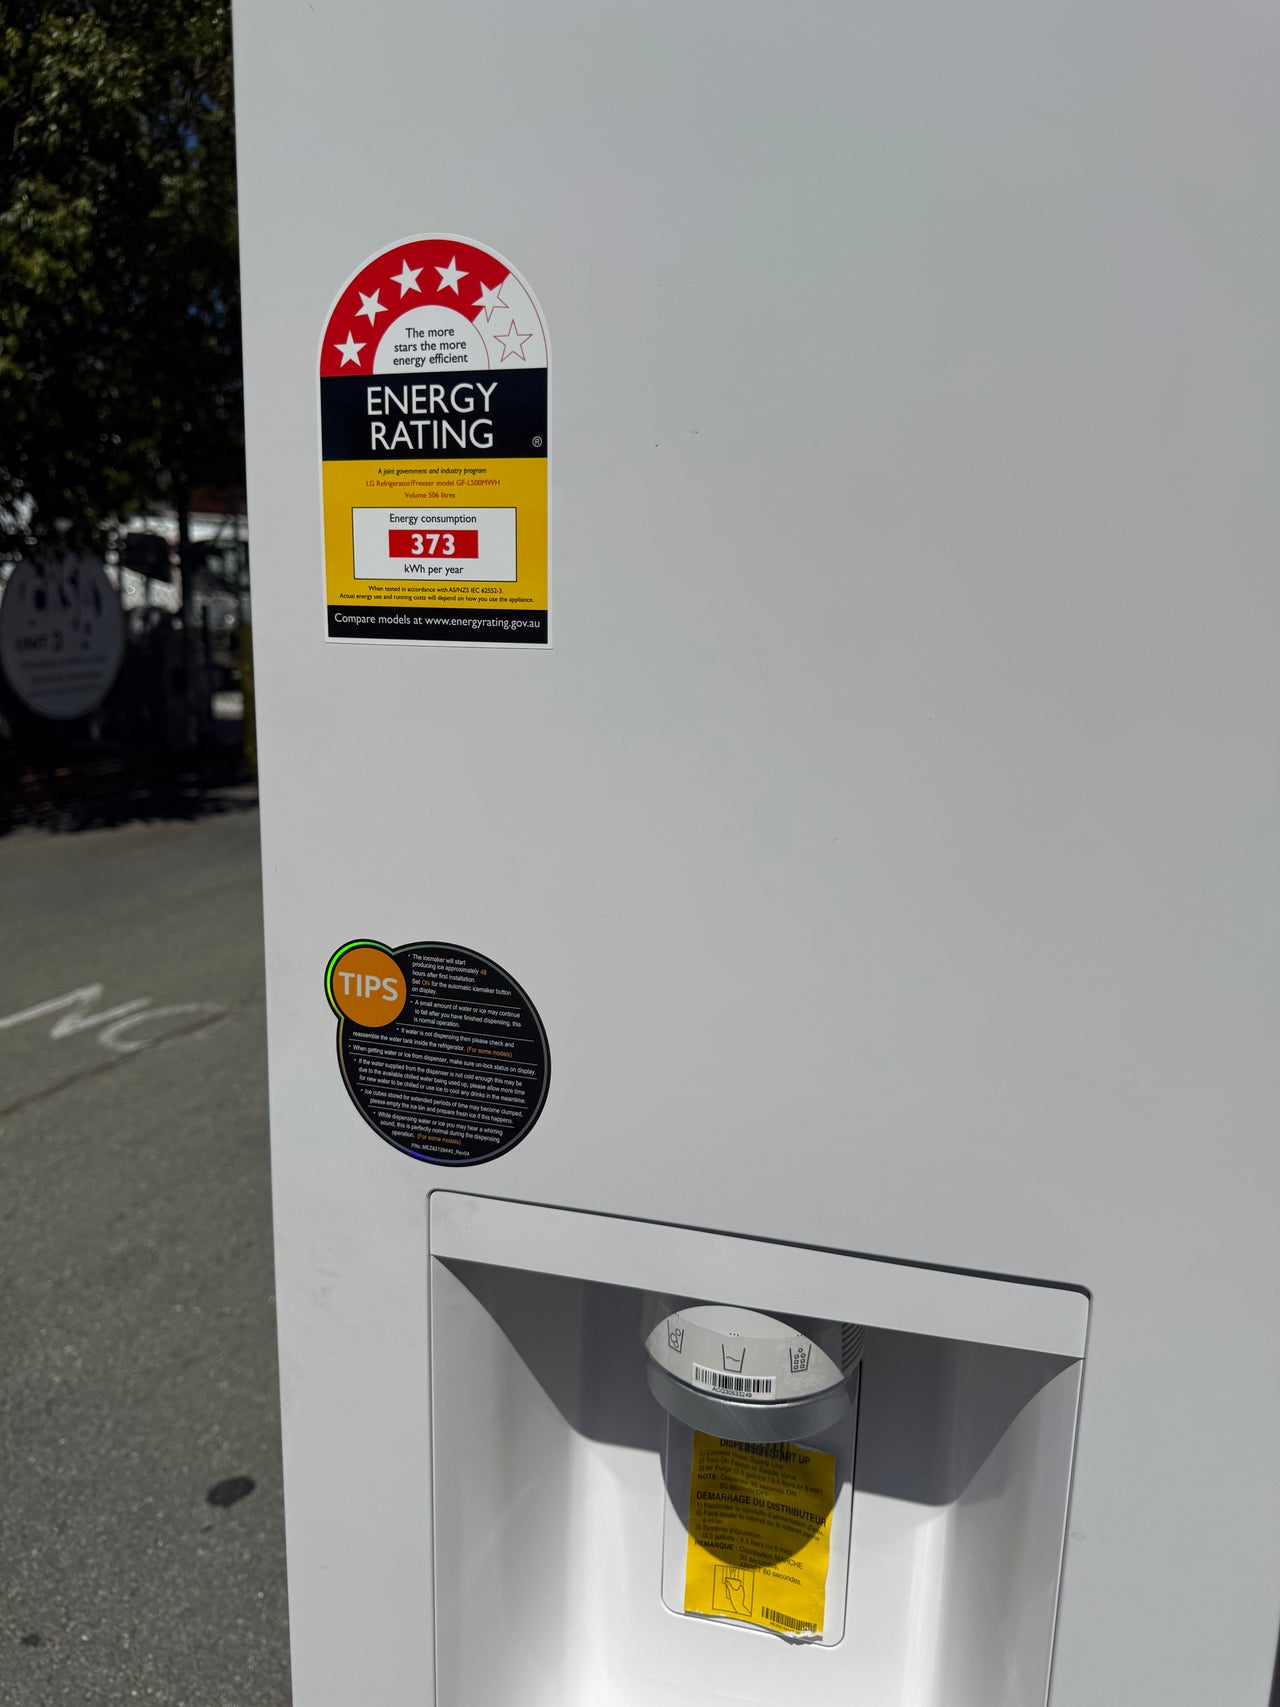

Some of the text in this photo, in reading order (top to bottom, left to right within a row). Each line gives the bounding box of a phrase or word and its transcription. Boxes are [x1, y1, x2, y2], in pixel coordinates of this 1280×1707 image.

[404, 327, 454, 338] The more
[394, 340, 466, 352] stars the more
[392, 352, 468, 367] energy efficient
[367, 382, 498, 415] ENERGY
[370, 418, 493, 449] RATING
[382, 468, 395, 476] joint
[440, 467, 463, 475] industry
[365, 480, 376, 488] LG
[435, 479, 454, 487] model
[426, 490, 440, 498] 506
[389, 513, 476, 525] Energy consumption
[411, 533, 455, 554] 373
[404, 563, 464, 576] kWh per year
[334, 612, 375, 625] Compare
[378, 614, 410, 624] models
[424, 617, 540, 629] www.energyrating.gov.au
[411, 961, 436, 970] producing
[444, 965, 479, 975] approximately
[337, 971, 398, 1001] TIPS
[418, 986, 437, 995] display.
[420, 979, 430, 988] ON
[472, 985, 495, 993] icemaker
[413, 1008, 420, 1017] to
[428, 1010, 440, 1019] after
[463, 1014, 482, 1022] finished
[352, 1031, 379, 1039] reassemble
[437, 1042, 465, 1050] refrigerator.
[433, 1031, 459, 1041] dispensing
[367, 1047, 383, 1055] getting
[517, 1067, 536, 1076] display.
[798, 1454, 811, 1465] UP
[696, 1490, 750, 1505] DÉMARRAGE
[753, 1497, 765, 1507] DU
[767, 1500, 826, 1527] DISTRIBUTEUR
[774, 1553, 803, 1570] MARCHE
